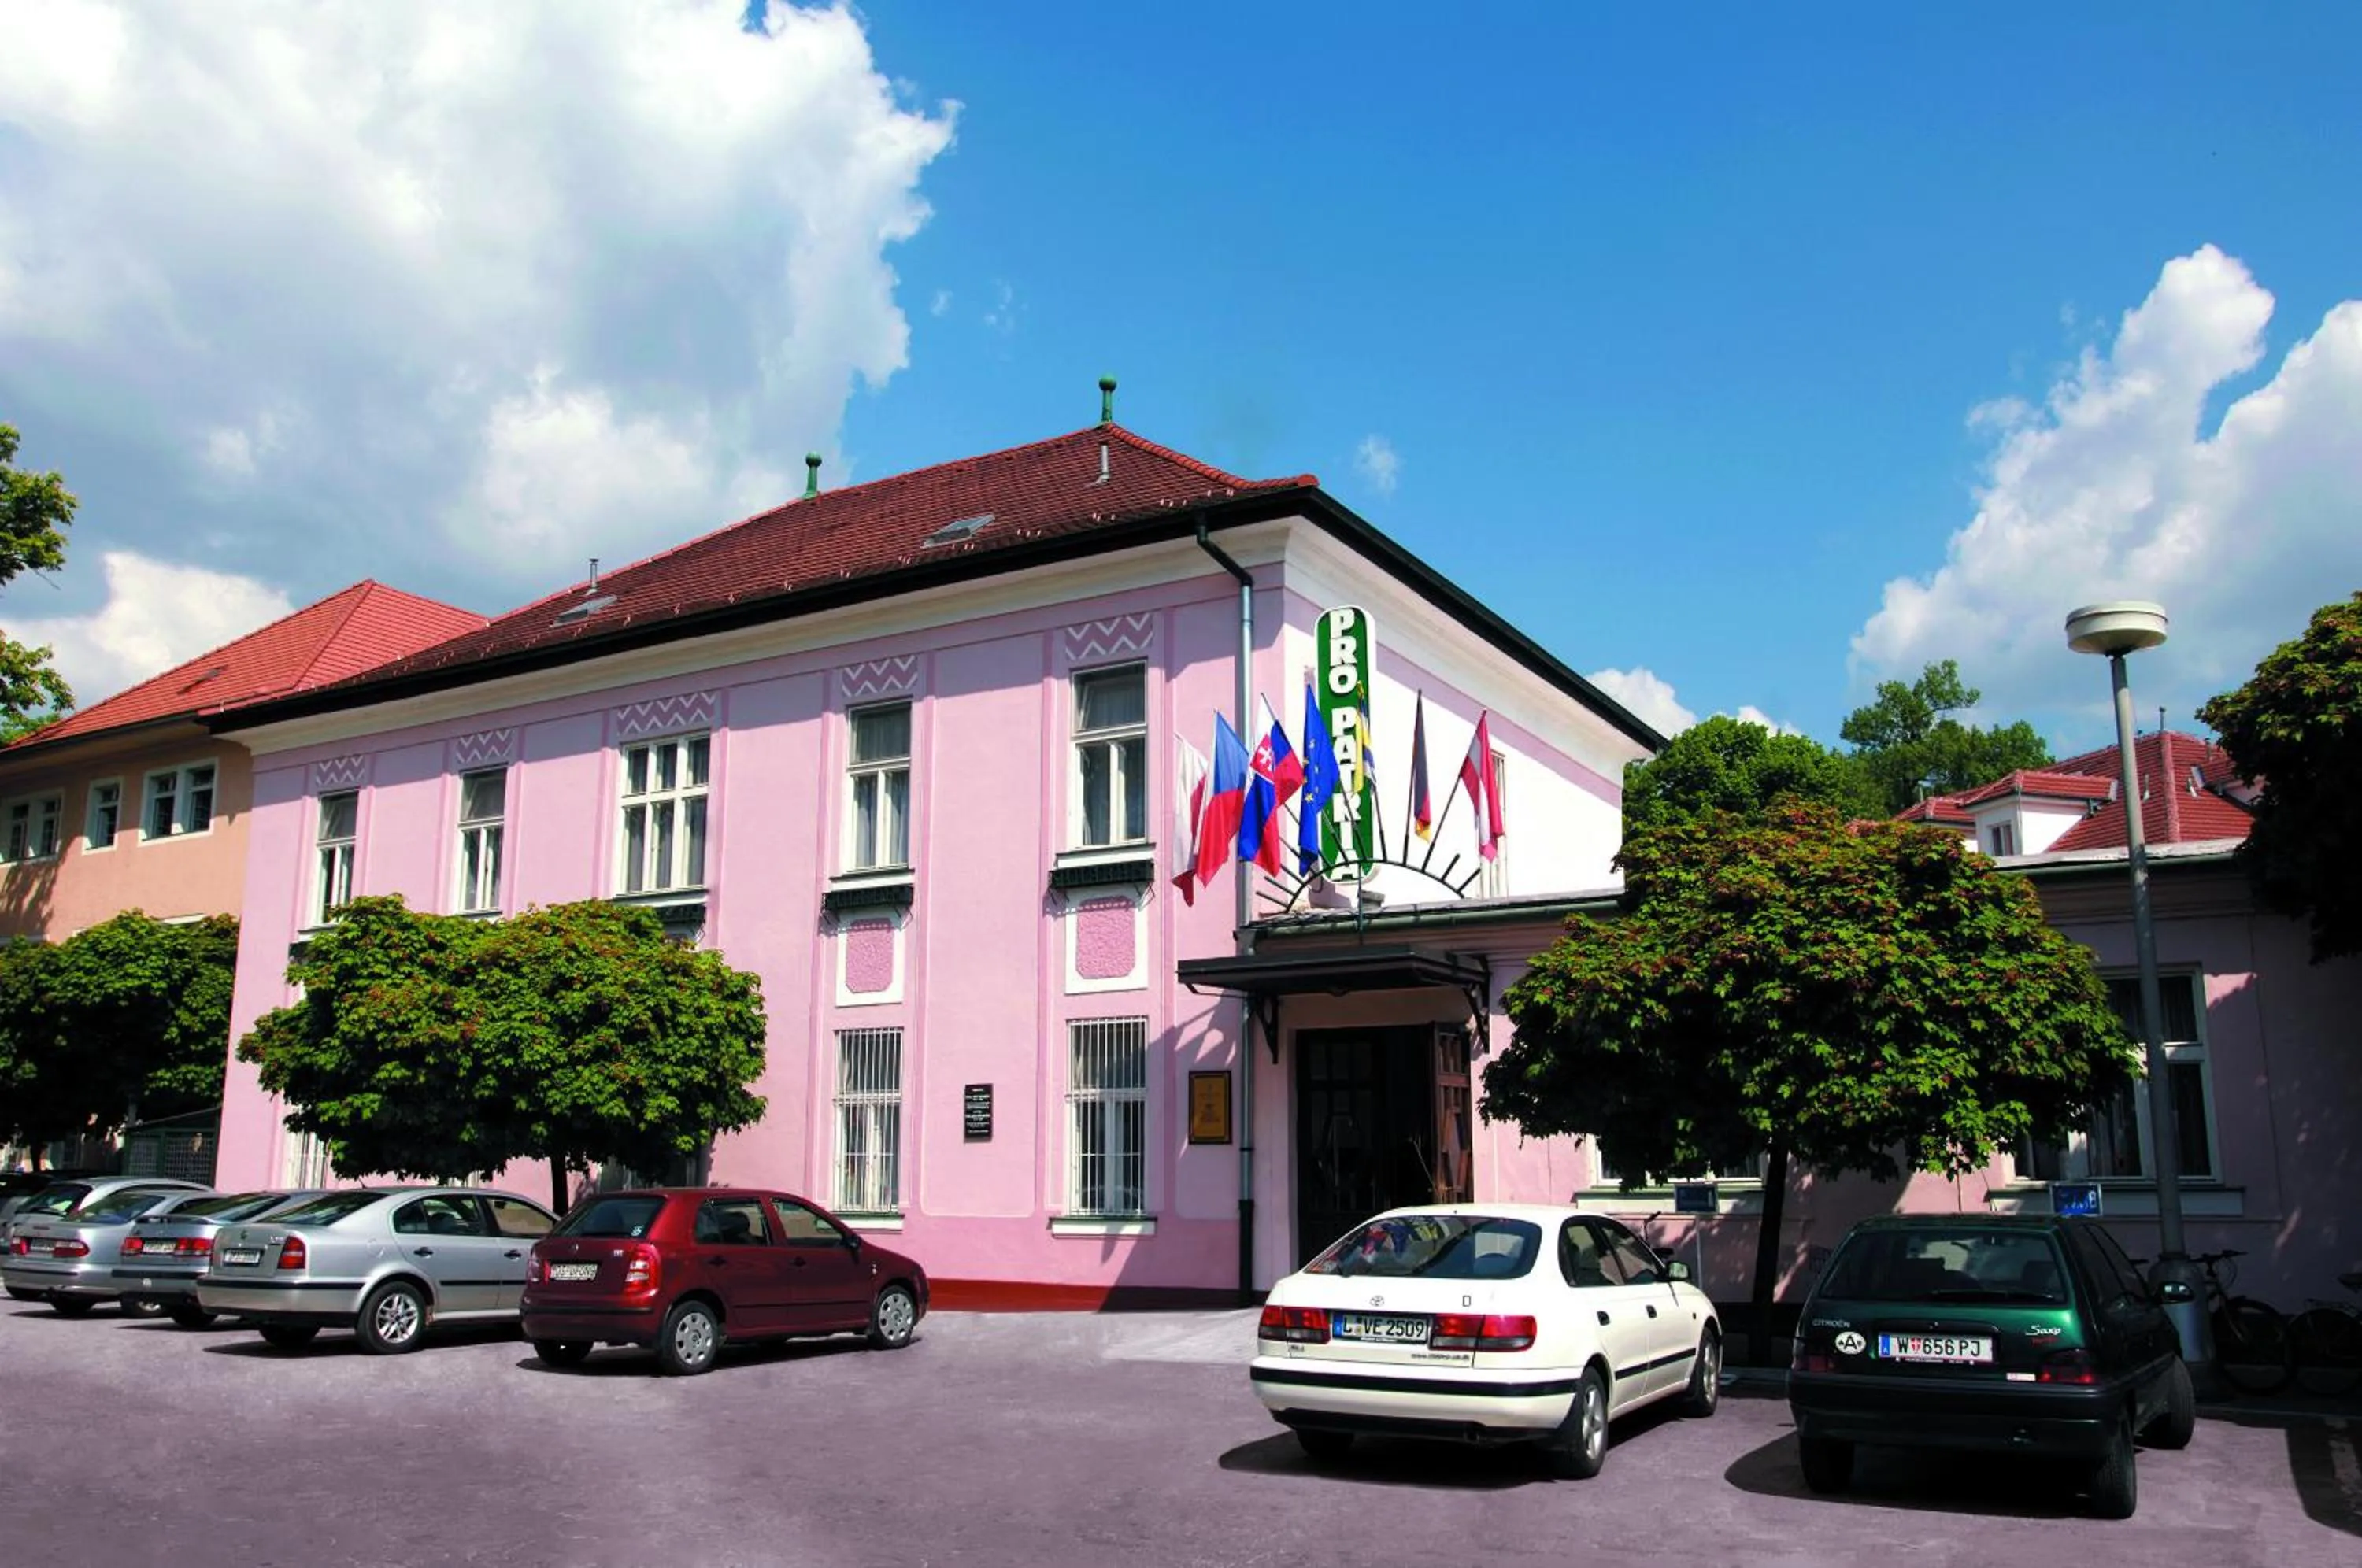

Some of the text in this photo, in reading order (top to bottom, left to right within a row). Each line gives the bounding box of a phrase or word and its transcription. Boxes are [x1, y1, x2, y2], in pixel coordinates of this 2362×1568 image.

[1329, 608, 1361, 881] PRO PATRIA
[1364, 1318, 1382, 1335] VE
[1386, 1319, 1424, 1337] 2509
[1844, 1335, 1857, 1350] A
[1897, 1337, 1980, 1357] W 656 PJ
